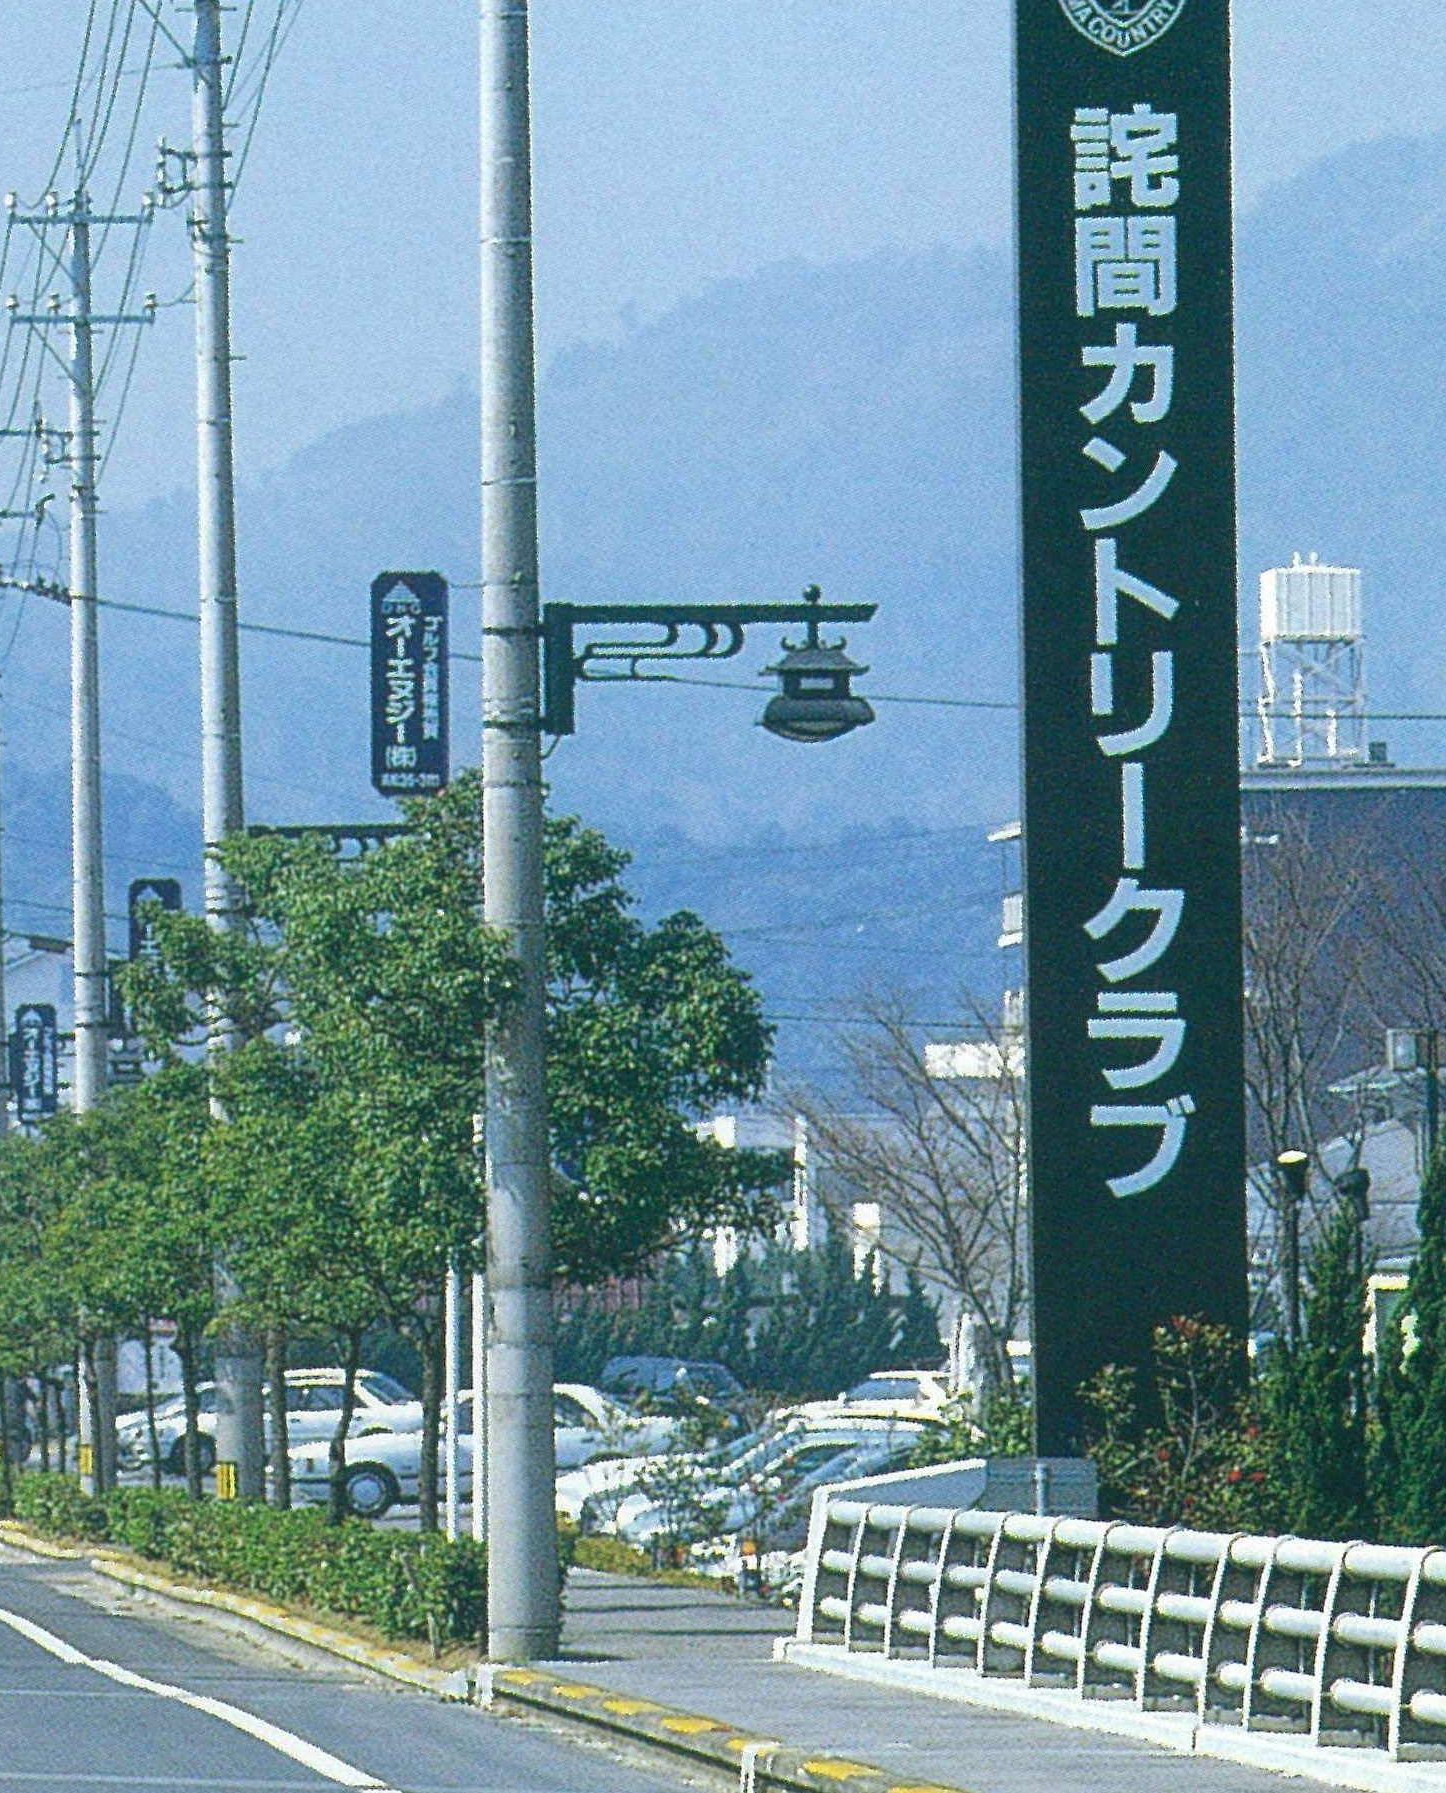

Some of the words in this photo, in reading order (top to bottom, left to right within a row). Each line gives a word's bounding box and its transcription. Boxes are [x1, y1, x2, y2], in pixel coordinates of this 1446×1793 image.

[1069, 103, 1196, 1198] 詫間カントリークラブ
